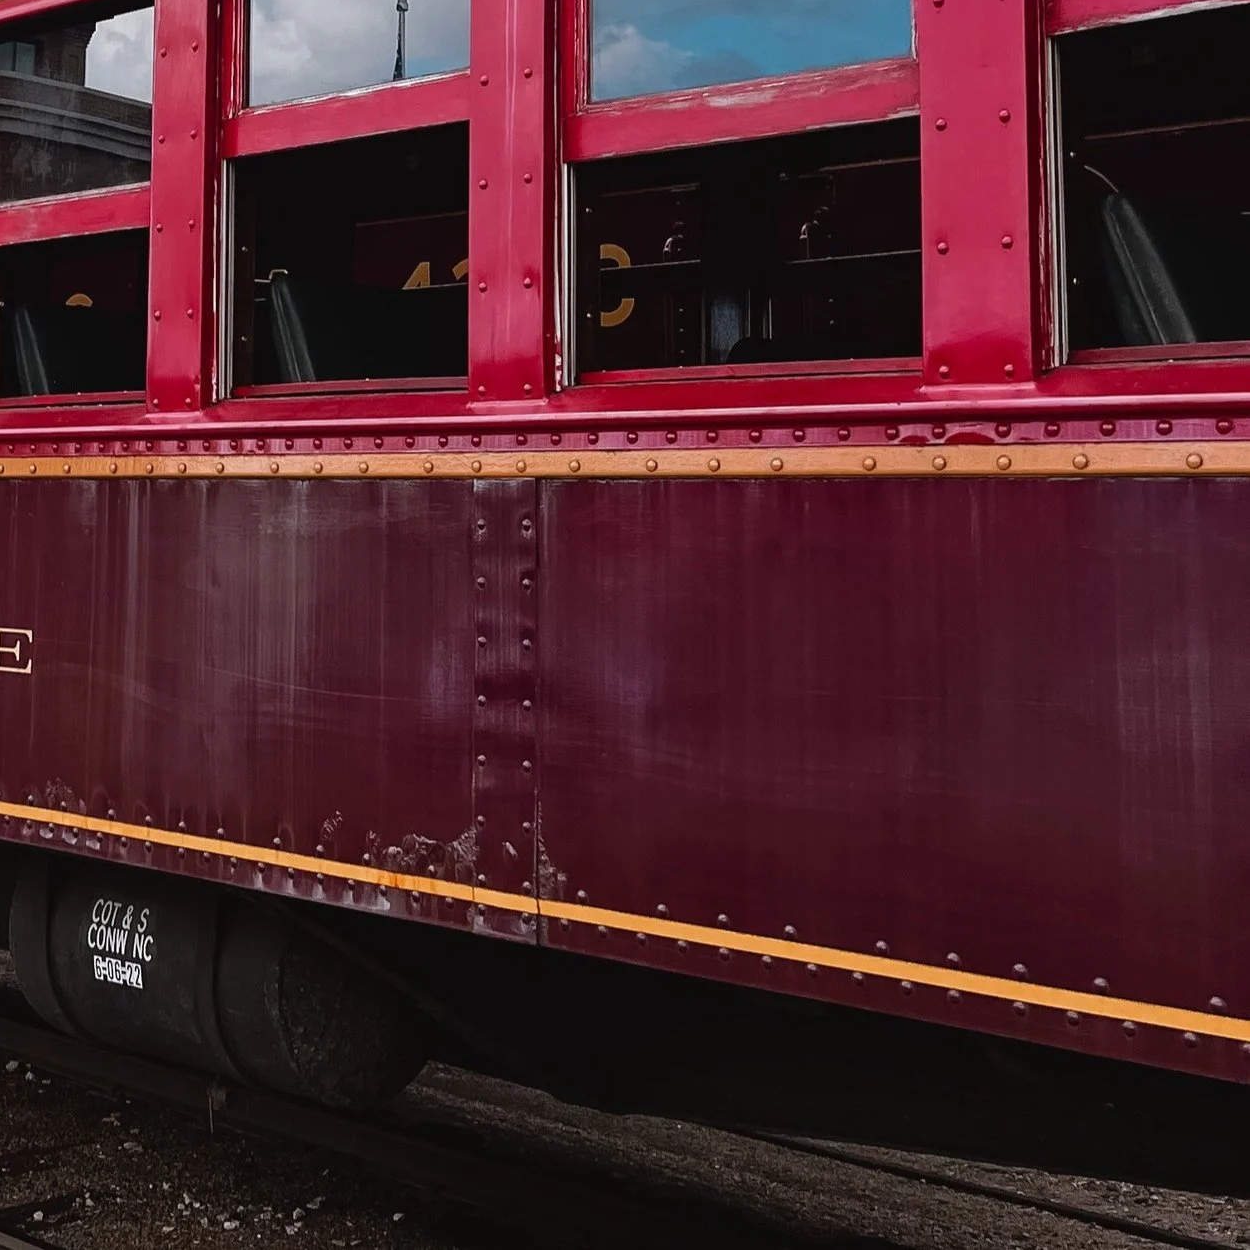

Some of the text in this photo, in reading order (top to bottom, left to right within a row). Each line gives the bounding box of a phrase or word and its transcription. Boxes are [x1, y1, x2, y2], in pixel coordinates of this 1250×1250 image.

[92, 899, 150, 932] COT & S
[87, 924, 154, 962] CONW NC
